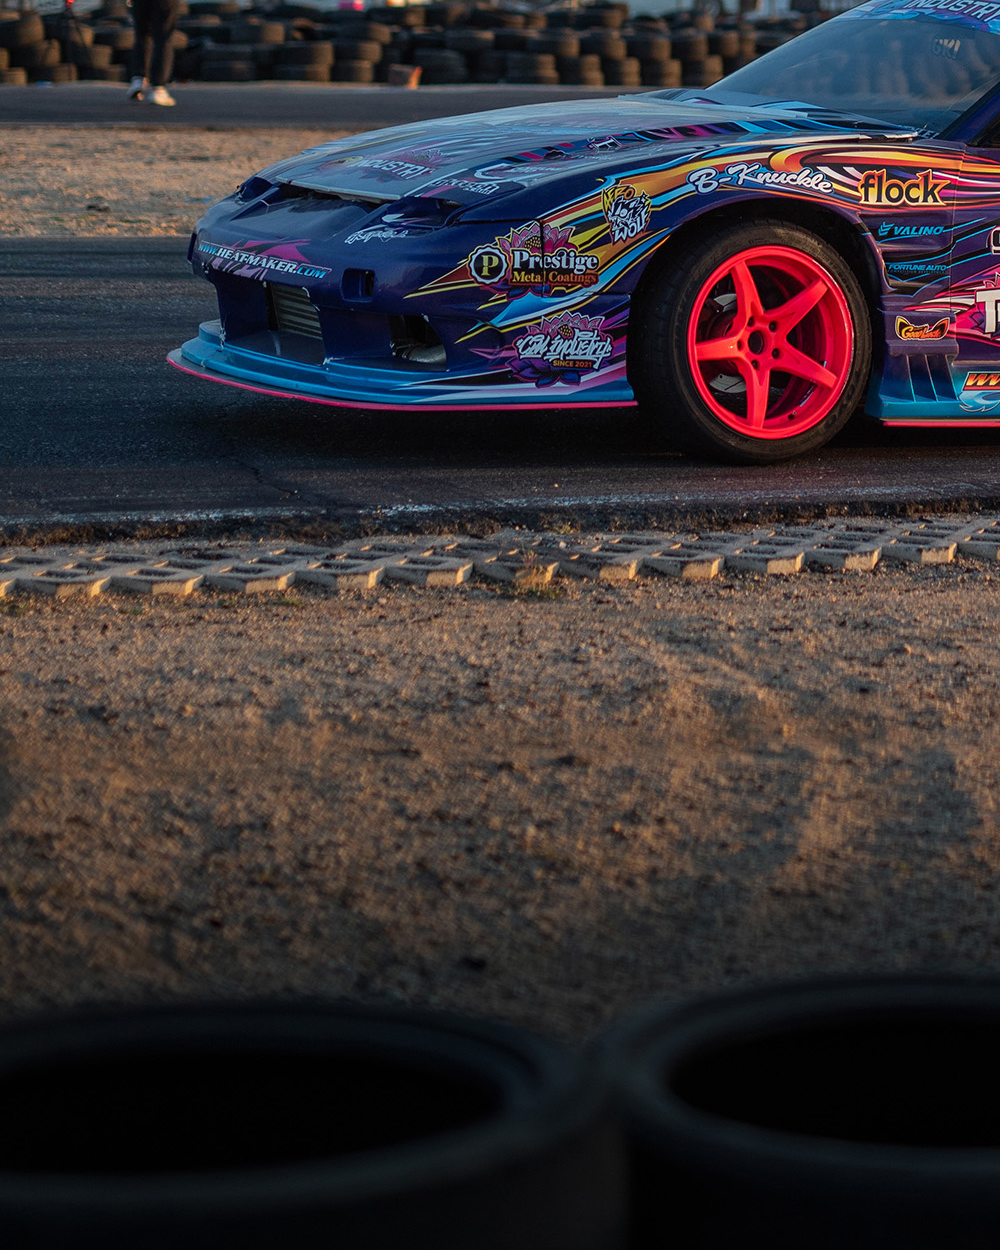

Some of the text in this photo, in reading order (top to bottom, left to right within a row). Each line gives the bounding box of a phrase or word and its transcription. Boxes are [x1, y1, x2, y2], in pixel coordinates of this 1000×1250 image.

[692, 163, 834, 194] B-Knuckle
[860, 172, 941, 203] flock
[613, 206, 648, 242] WOLF
[894, 226, 944, 236] VALINO
[481, 254, 499, 276] P
[513, 251, 598, 275] Prestige
[888, 263, 948, 271] FORTUNE AUTO
[512, 271, 597, 285] Metal Coatings
